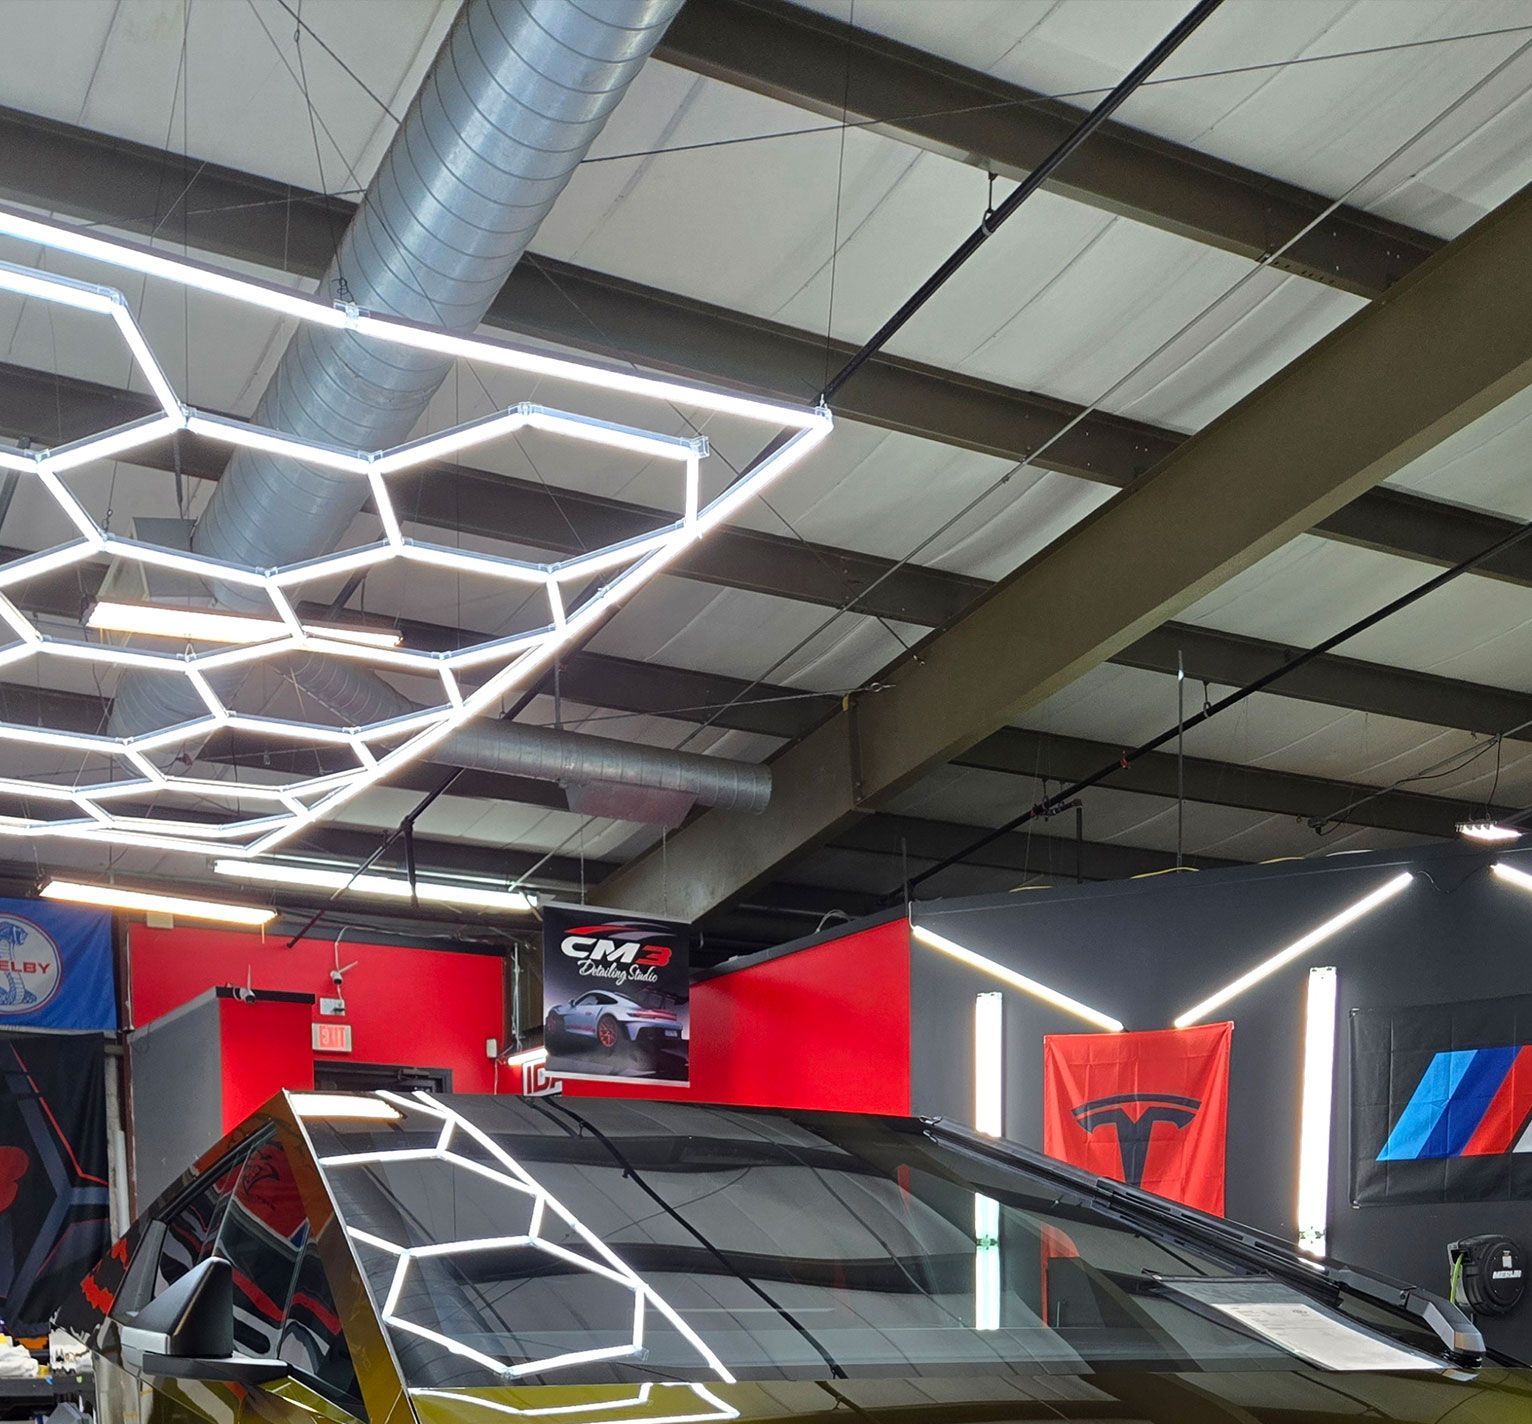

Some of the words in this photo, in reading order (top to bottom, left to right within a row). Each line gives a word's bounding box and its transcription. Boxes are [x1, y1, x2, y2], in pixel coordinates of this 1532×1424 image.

[561, 935, 672, 967] CM3
[0, 960, 51, 974] ELBY
[577, 959, 627, 986] Detailing
[628, 963, 658, 983] Studio
